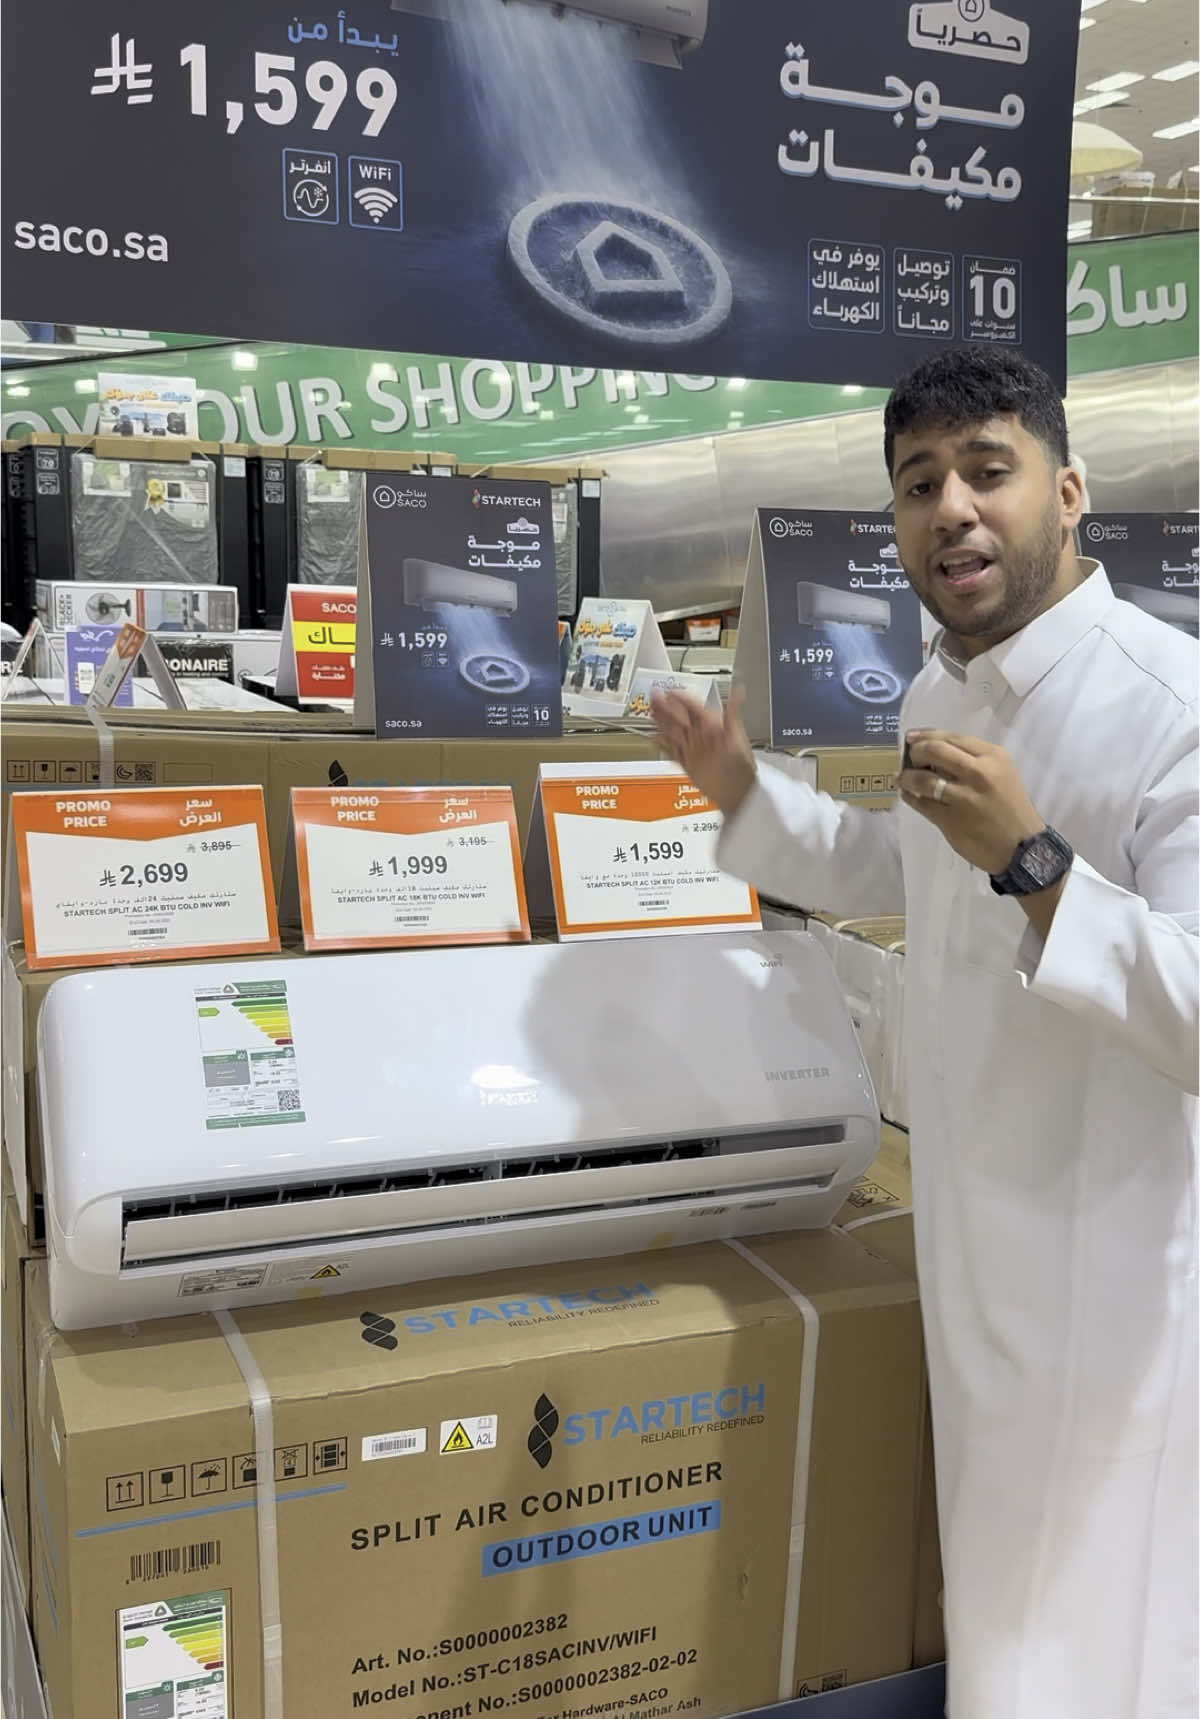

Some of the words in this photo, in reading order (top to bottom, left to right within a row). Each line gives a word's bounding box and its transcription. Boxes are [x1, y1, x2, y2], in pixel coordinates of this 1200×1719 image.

[287, 18, 328, 43] من
[338, 10, 399, 56] يبدأ
[179, 43, 399, 138] 1,599
[779, 42, 1026, 130] موجة
[288, 159, 332, 176] انفرتر
[358, 164, 392, 182] WiFi
[778, 129, 1023, 210] مكيفات
[14, 220, 169, 263] saco.sa
[812, 246, 842, 265] في
[847, 248, 880, 272] يوفر
[898, 254, 951, 280] توصيل
[811, 270, 880, 294] استهلاك
[897, 283, 950, 306] وتركيب
[969, 274, 1017, 320] 10
[1067, 260, 1188, 337] ساك
[812, 297, 880, 324] الكهرباء
[195, 378, 353, 447] OUR
[397, 499, 428, 508] SACO
[481, 495, 541, 507] STARTECH
[789, 529, 813, 537] SACO
[857, 524, 896, 534] STARTE
[1105, 532, 1128, 540] SACO
[1170, 525, 1199, 534] START
[467, 535, 541, 552] موجة
[468, 554, 542, 571] مكيفات
[848, 560, 905, 575] وجة
[1162, 560, 1199, 574] وجة
[849, 576, 910, 592] مكيفات
[1163, 576, 1199, 588] فات
[321, 602, 357, 614] SACO
[398, 632, 448, 650] 1,599
[165, 658, 229, 671] ONAIRE
[793, 648, 834, 665] 1,599
[385, 719, 423, 728] saco.sa
[534, 709, 549, 721] 10
[782, 728, 813, 737] saco.sa
[575, 786, 619, 797] PROMO
[55, 800, 111, 813] PROMO
[185, 798, 213, 811] سعر
[330, 796, 379, 807] PROMO
[444, 797, 469, 808] سعر
[582, 799, 617, 810] PRICE
[63, 815, 108, 828] PRICE
[179, 811, 222, 827] العرض
[337, 810, 376, 822] PRICE
[439, 808, 478, 823] العرض
[200, 841, 232, 853] 3,895
[458, 836, 487, 847] 3,195
[630, 841, 684, 864] 1,599
[119, 862, 189, 888] 2,699
[388, 855, 448, 878] 1,999
[337, 896, 375, 904] STARTECH
[376, 895, 396, 903] SPLIT
[64, 908, 106, 917] STARTECH
[107, 907, 129, 915] SPLIT
[765, 1067, 831, 1083] INVERTER
[404, 1281, 657, 1334] STARTECH
[507, 1309, 585, 1328] RELIABILITY
[588, 1298, 660, 1316] REDEFINED
[563, 1384, 766, 1446] STARTECH
[640, 1422, 704, 1446] RELIABILITY
[706, 1413, 766, 1434] REDEFINED
[476, 1432, 494, 1446] A2L
[351, 1514, 442, 1551] SPLIT
[454, 1501, 508, 1532] AIR
[520, 1461, 724, 1518] CONDITIONER
[492, 1521, 640, 1569] OUTDOOR
[648, 1506, 713, 1537] UNIT
[351, 1656, 390, 1675] Art.
[396, 1613, 568, 1665] No.:S0000002382
[352, 1680, 415, 1708] Model
[421, 1626, 658, 1694] No.:ST-C18SACINV/WIFI
[478, 1649, 698, 1714] No.:S0000002382-02-02
[562, 1688, 669, 1719] Hardware-SACO
[677, 1697, 702, 1711] Ash
